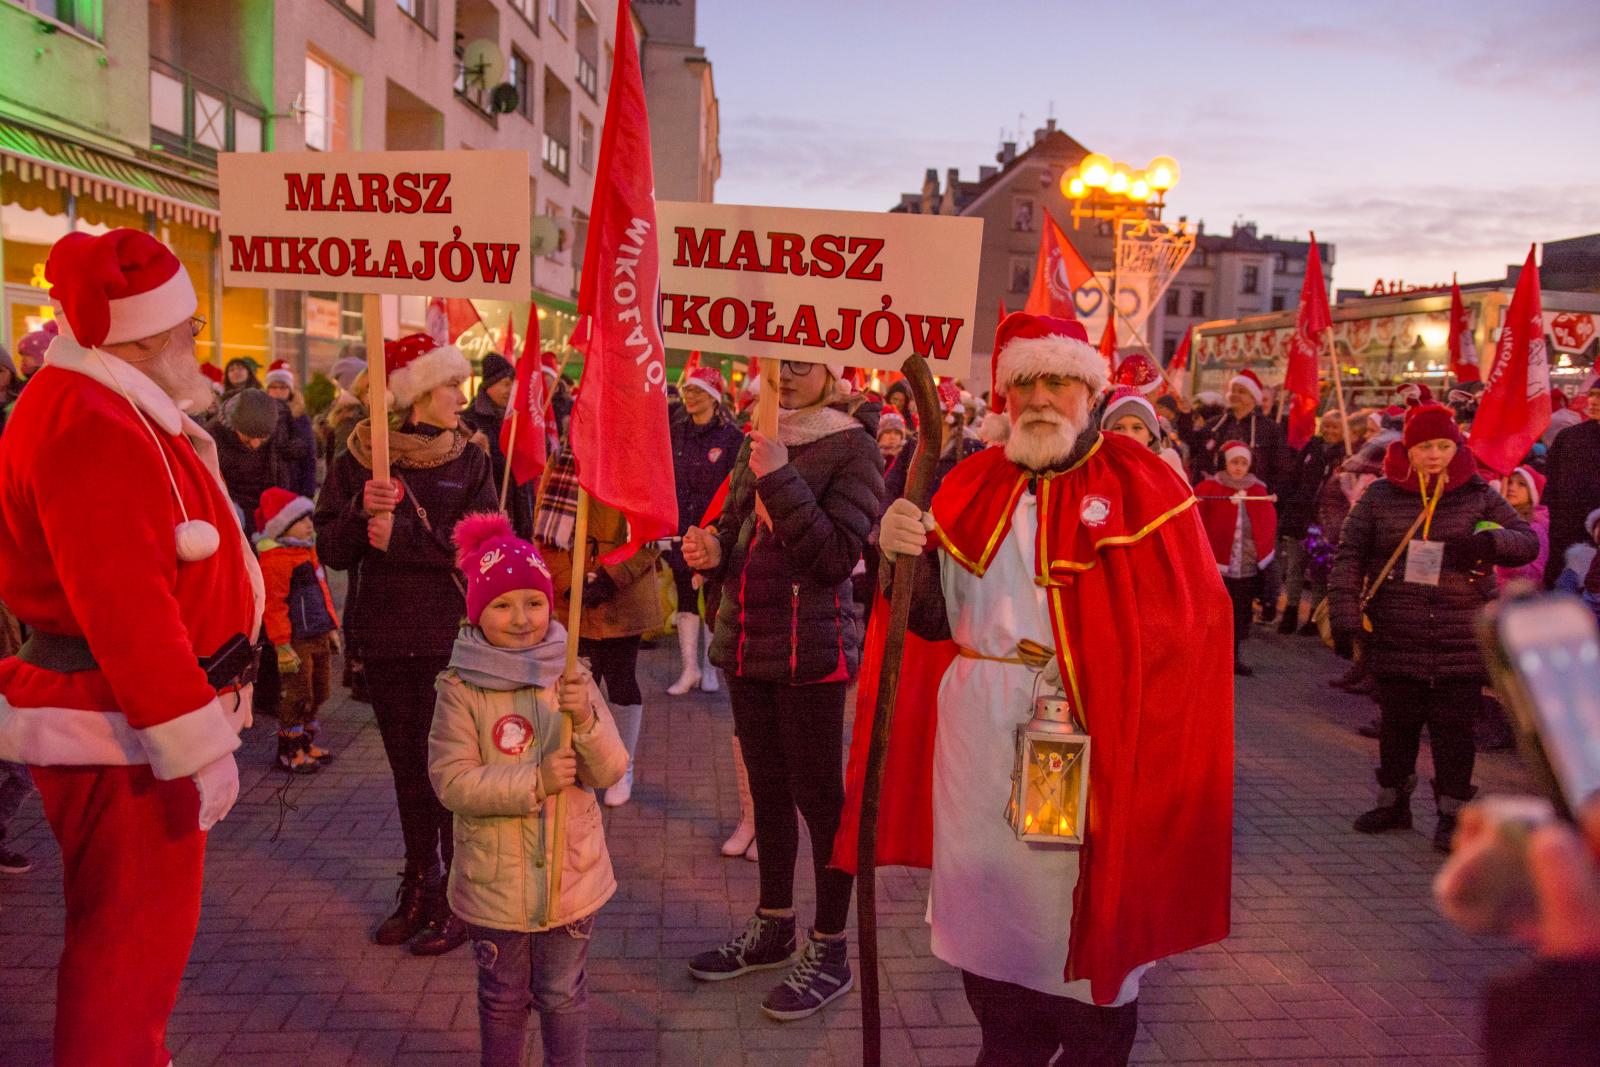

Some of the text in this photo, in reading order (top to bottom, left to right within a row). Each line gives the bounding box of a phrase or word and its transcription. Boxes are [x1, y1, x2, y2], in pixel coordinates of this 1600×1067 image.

[284, 173, 452, 214] MARSZ
[228, 225, 521, 284] MIKOŁAJÓW
[673, 226, 885, 282] MARSZ
[661, 294, 965, 361] KOŁAJÓW
